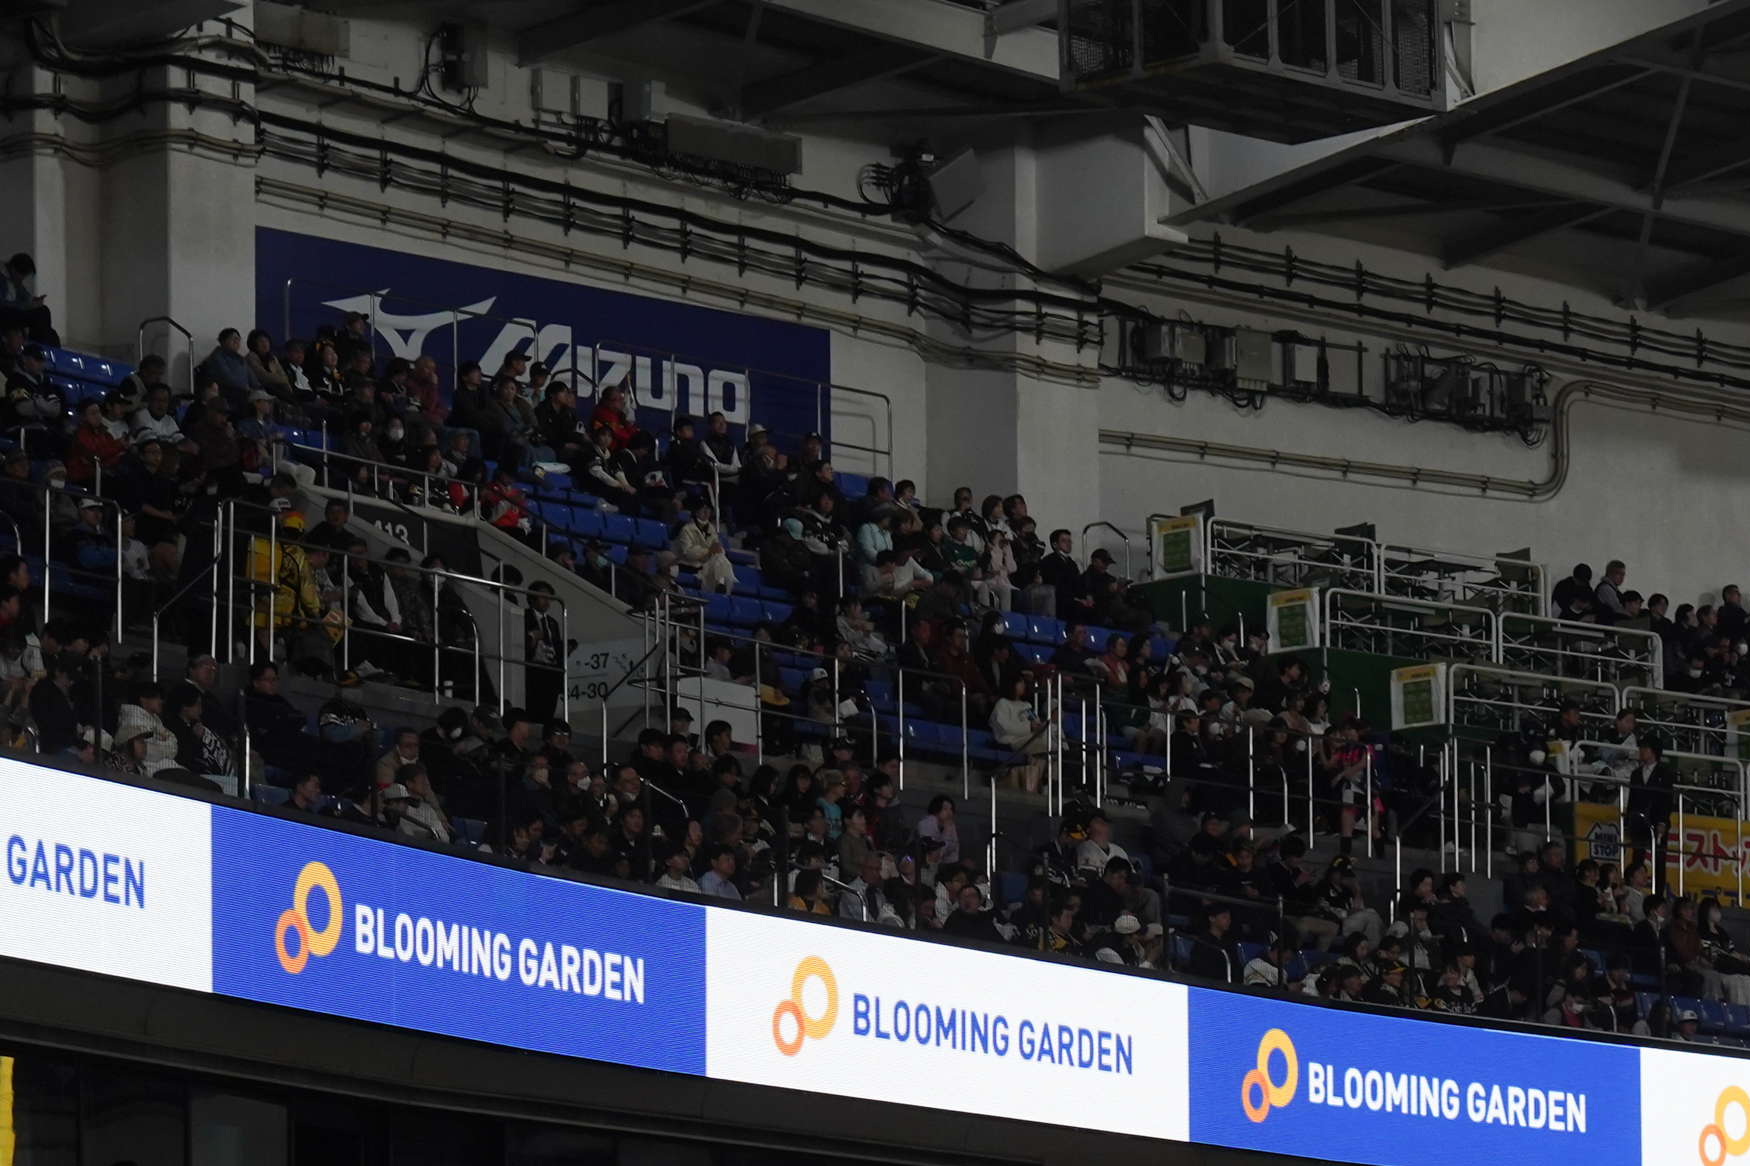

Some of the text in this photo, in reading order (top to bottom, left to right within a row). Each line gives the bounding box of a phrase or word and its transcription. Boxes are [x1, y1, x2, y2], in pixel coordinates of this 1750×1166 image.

[6, 834, 145, 910] GARDEN
[1594, 844, 1620, 857] STOP
[355, 904, 646, 1004] BLOOMING GARDEN
[853, 993, 1133, 1075] BLOOMING GARDEN
[1308, 1062, 1587, 1133] BLOOMING GARDEN
